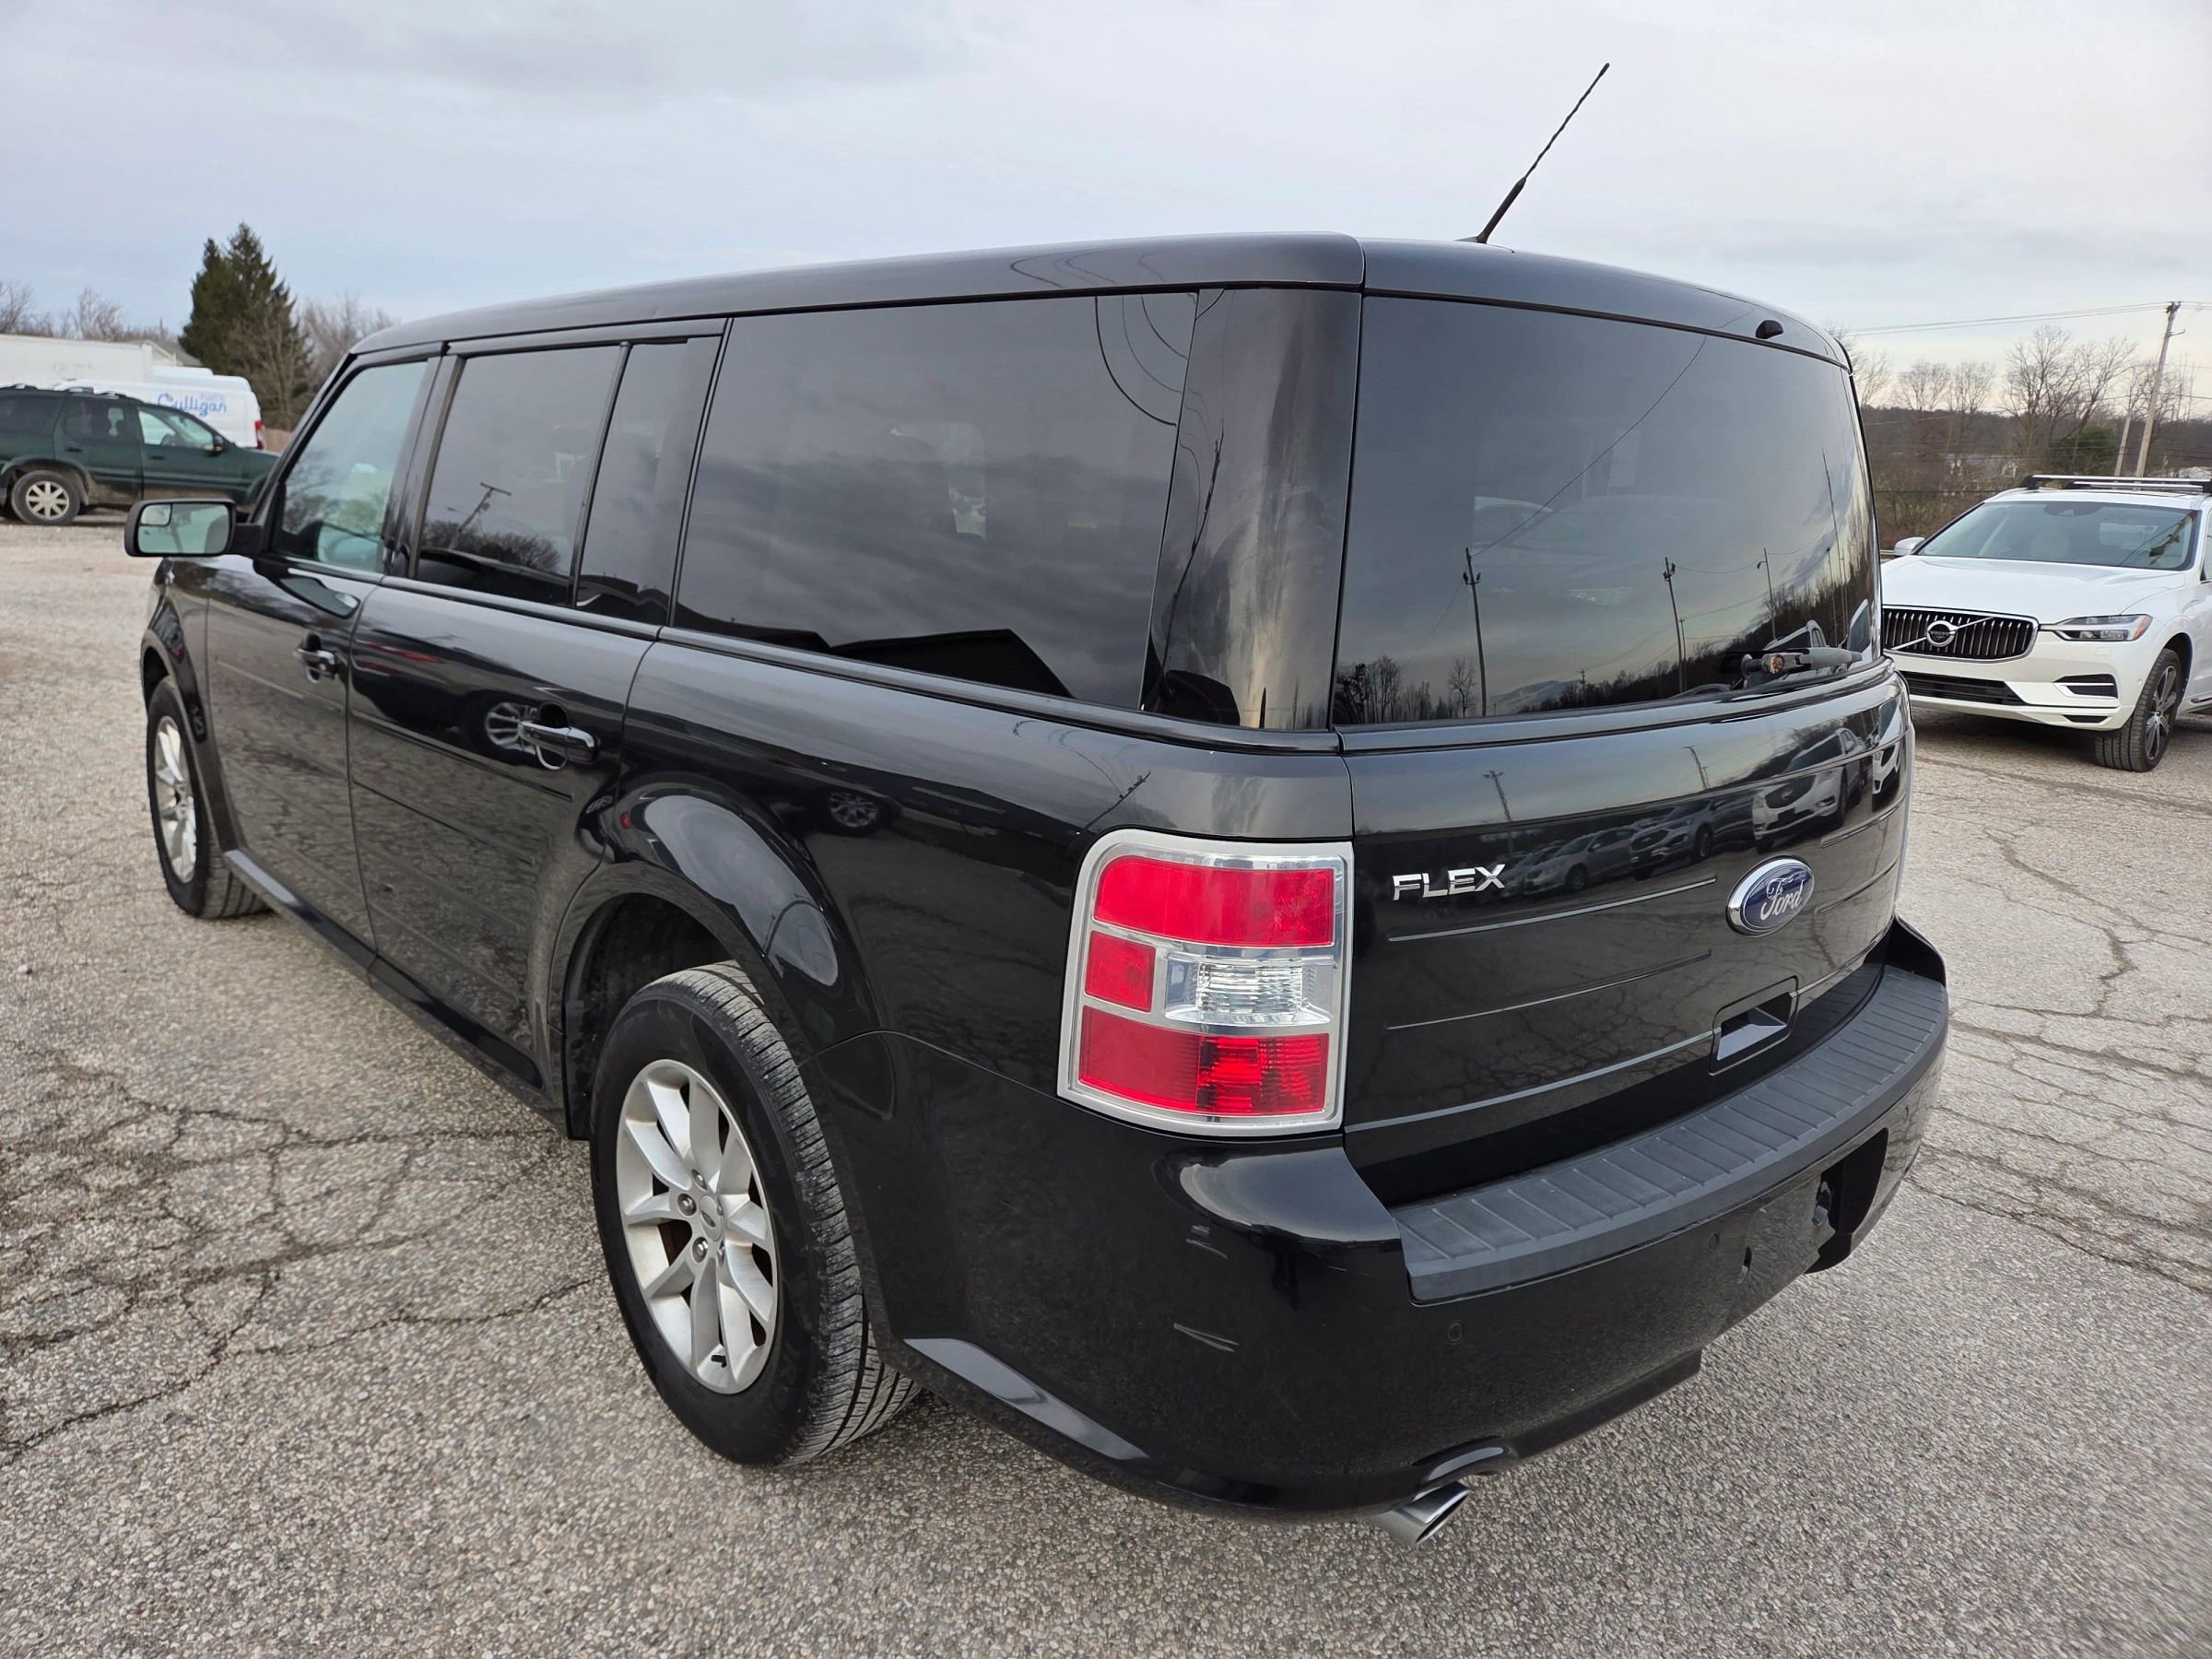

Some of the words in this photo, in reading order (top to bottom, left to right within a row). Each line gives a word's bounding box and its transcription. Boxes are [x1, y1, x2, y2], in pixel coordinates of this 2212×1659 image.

[158, 393, 227, 418] Culligan
[1393, 864, 1505, 900] FLEX
[1759, 873, 1805, 921] Ford
